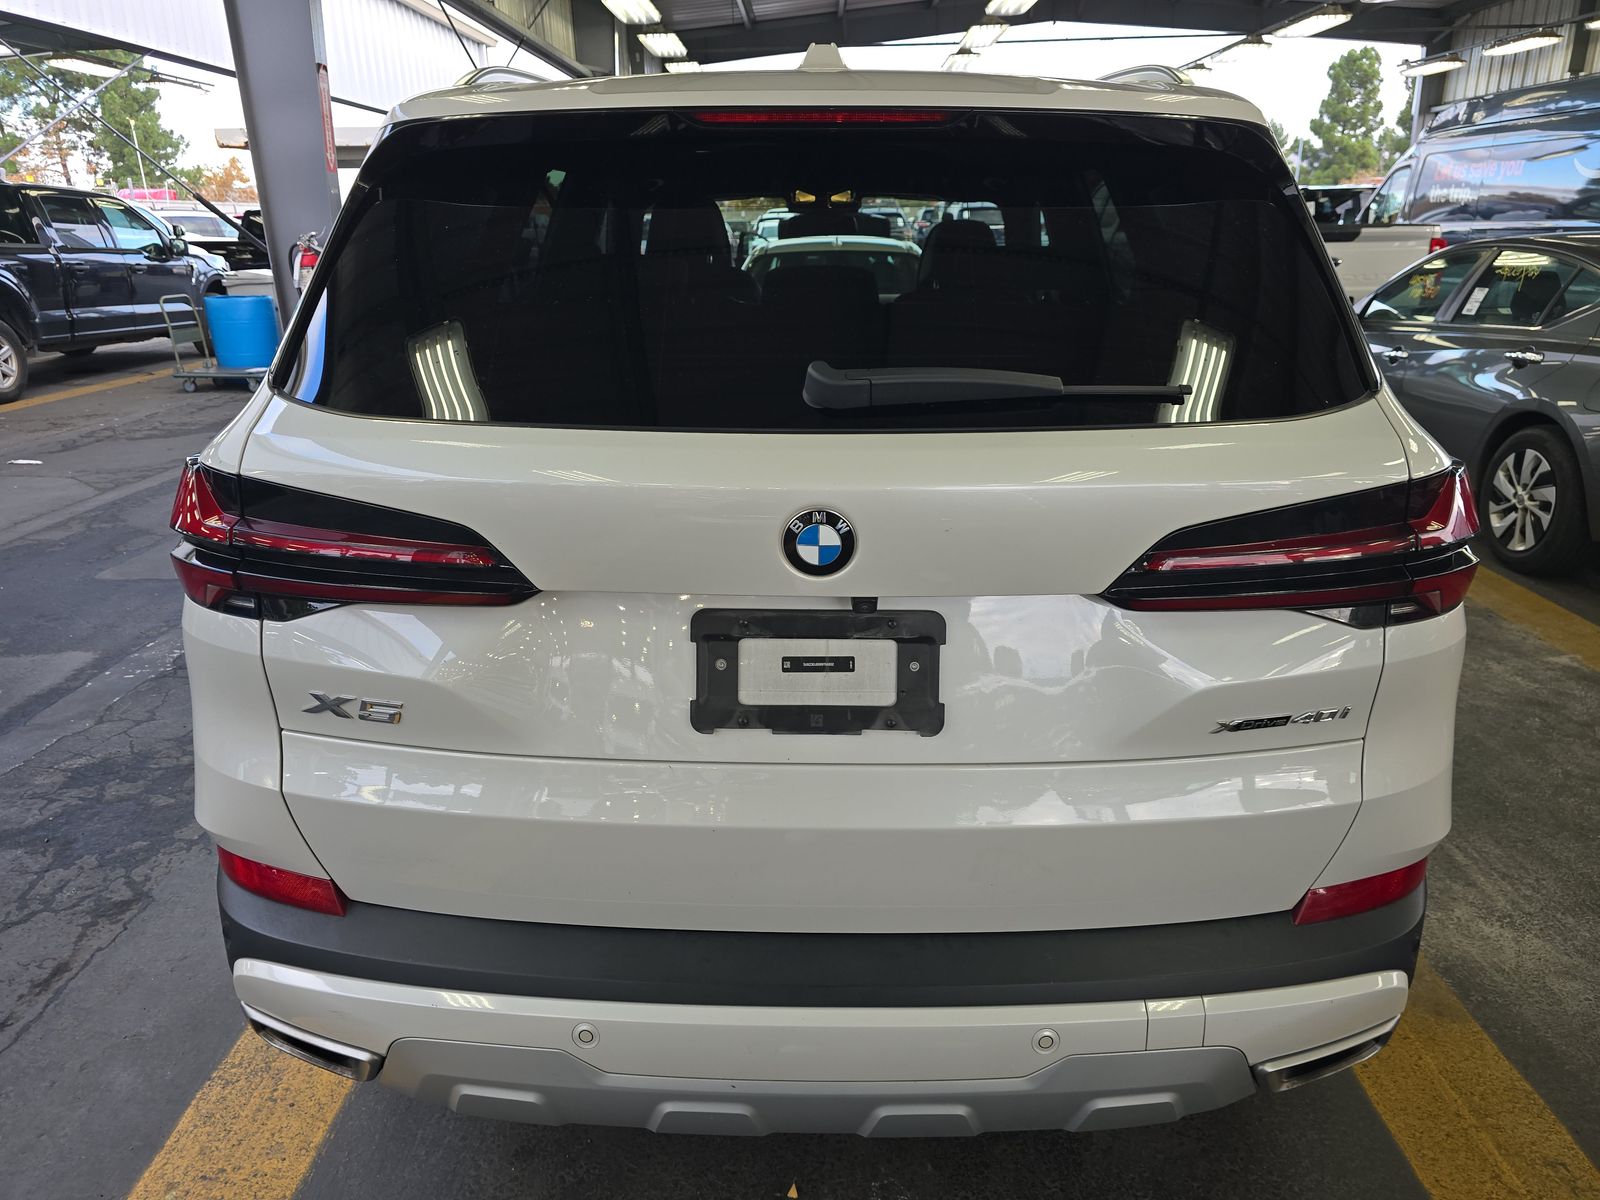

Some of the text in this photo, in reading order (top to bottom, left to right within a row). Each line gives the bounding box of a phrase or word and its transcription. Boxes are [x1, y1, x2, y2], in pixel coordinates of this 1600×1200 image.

[1497, 159, 1526, 180] you
[1429, 184, 1447, 203] the
[789, 511, 850, 535] BMW
[302, 690, 403, 724] X5
